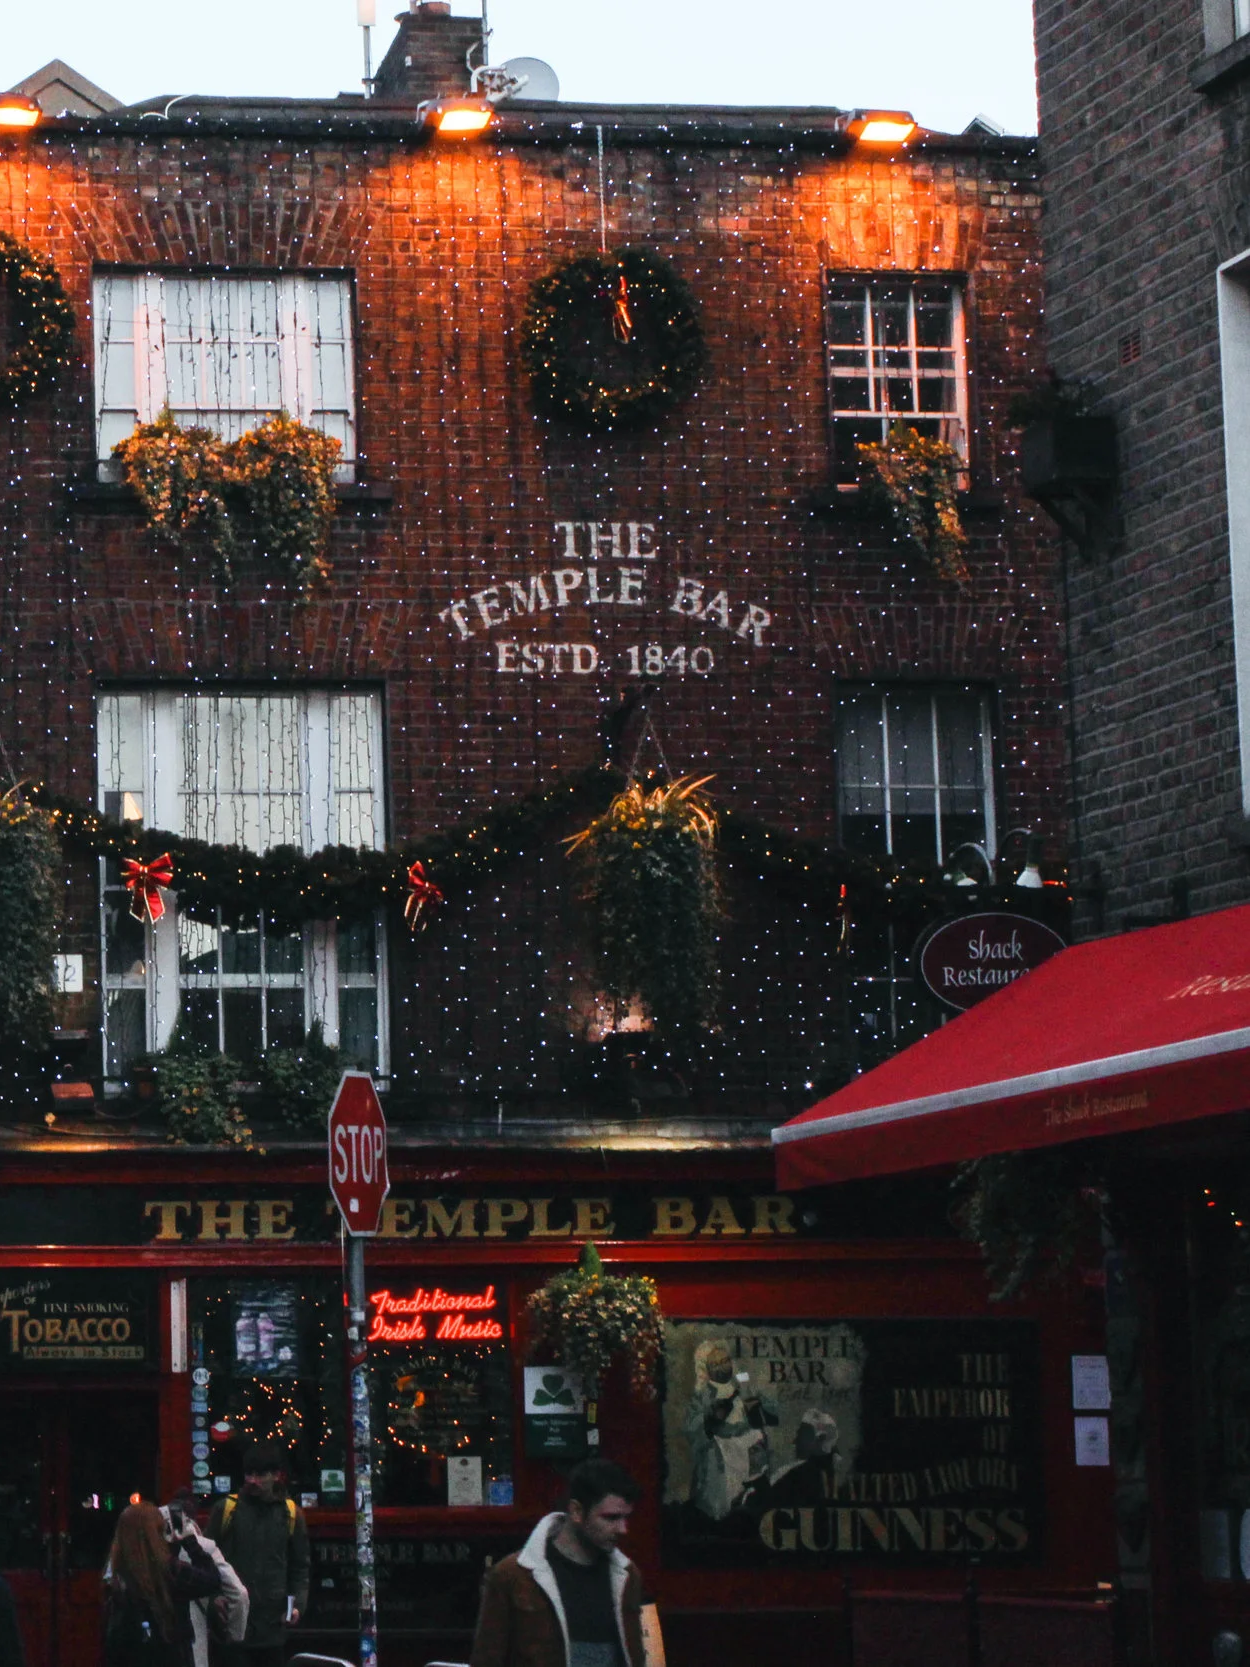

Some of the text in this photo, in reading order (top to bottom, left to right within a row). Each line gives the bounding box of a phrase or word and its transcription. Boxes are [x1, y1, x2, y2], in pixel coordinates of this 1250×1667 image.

[554, 521, 656, 559] THE
[438, 566, 772, 647] TEMPLE BAR
[626, 645, 715, 676] 1840
[968, 929, 1024, 963] Shack
[335, 1123, 384, 1184] STOP
[145, 1200, 296, 1240] THE
[654, 1197, 797, 1236] BAR
[43, 1302, 129, 1313] FINE SMOKING
[370, 1285, 496, 1314] Traditional
[368, 1313, 503, 1341] Irish Music
[728, 1335, 860, 1359] TEMPLE
[769, 1361, 829, 1385] BAR
[959, 1353, 1010, 1383] THE
[893, 1388, 1012, 1418] EMPEROR
[759, 1506, 1029, 1552] GUINNESS
